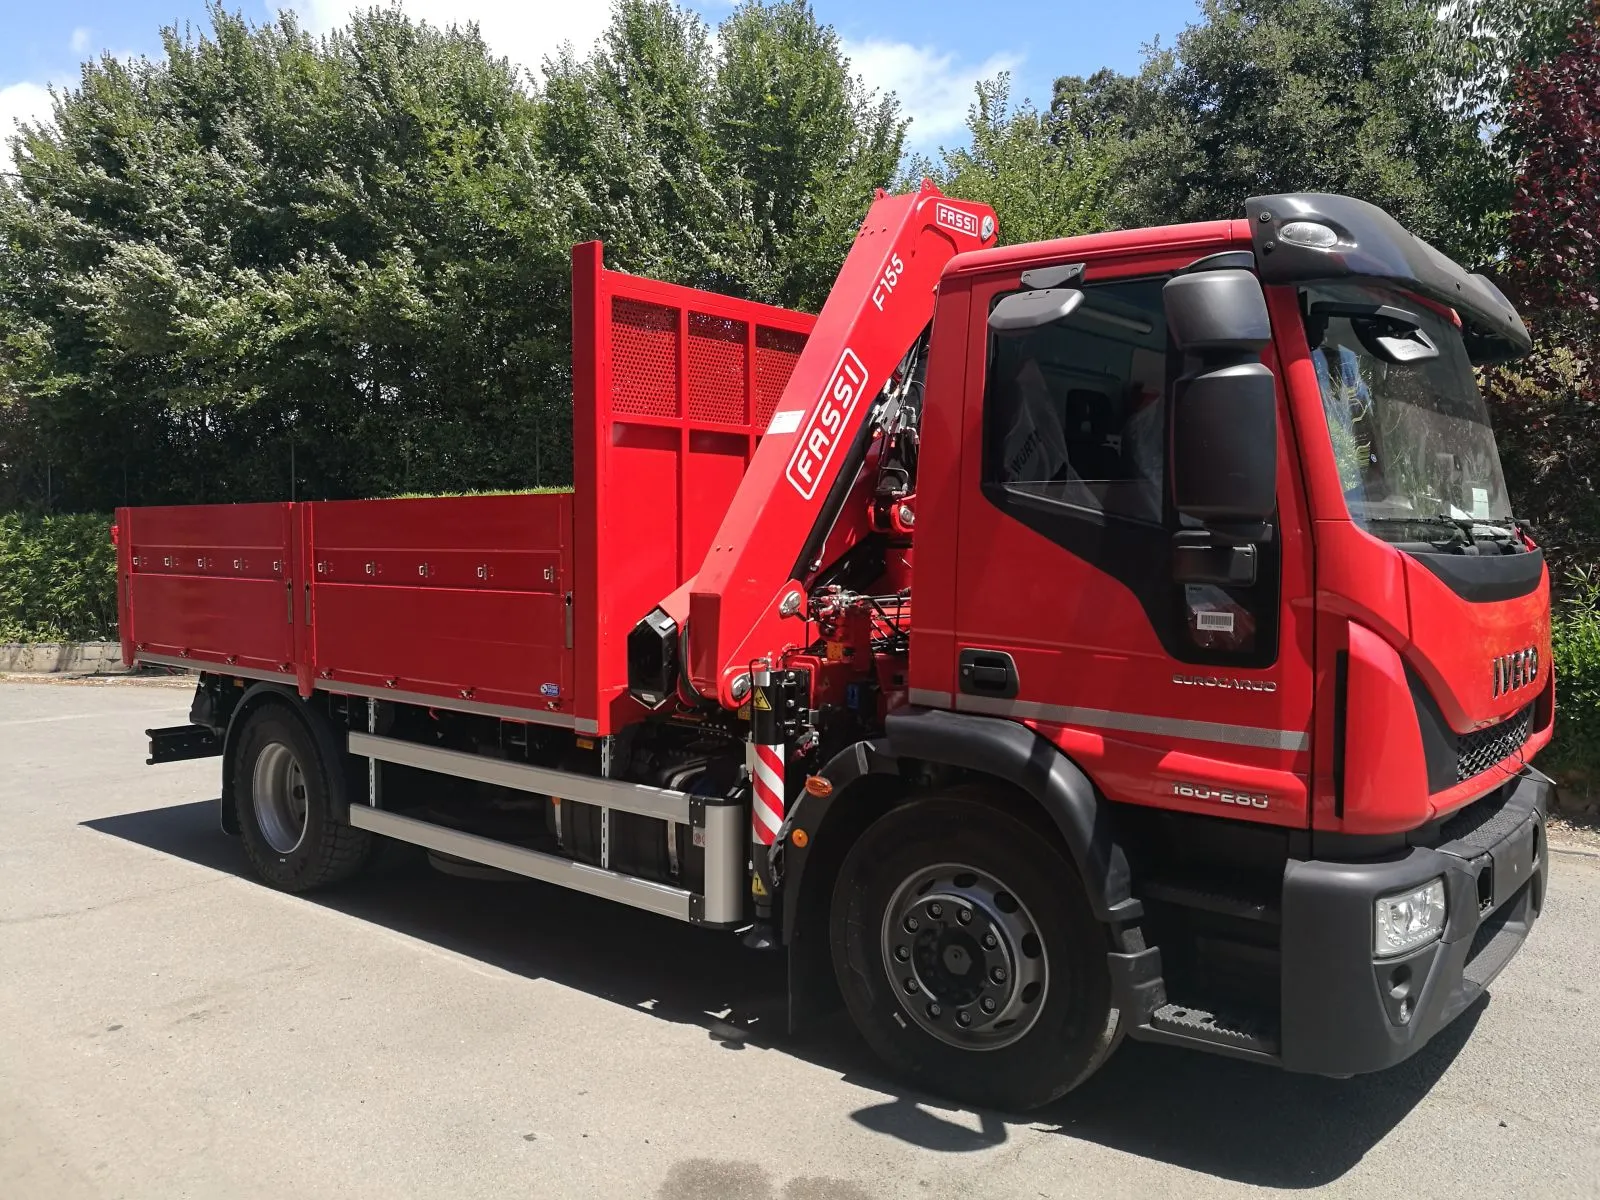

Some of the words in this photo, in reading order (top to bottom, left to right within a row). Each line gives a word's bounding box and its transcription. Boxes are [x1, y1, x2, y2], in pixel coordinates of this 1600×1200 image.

[940, 208, 975, 232] FASSI
[872, 252, 904, 312] F155
[797, 363, 860, 484] FASSI
[1172, 674, 1277, 692] EUROCARGO
[1492, 645, 1539, 699] IVECO
